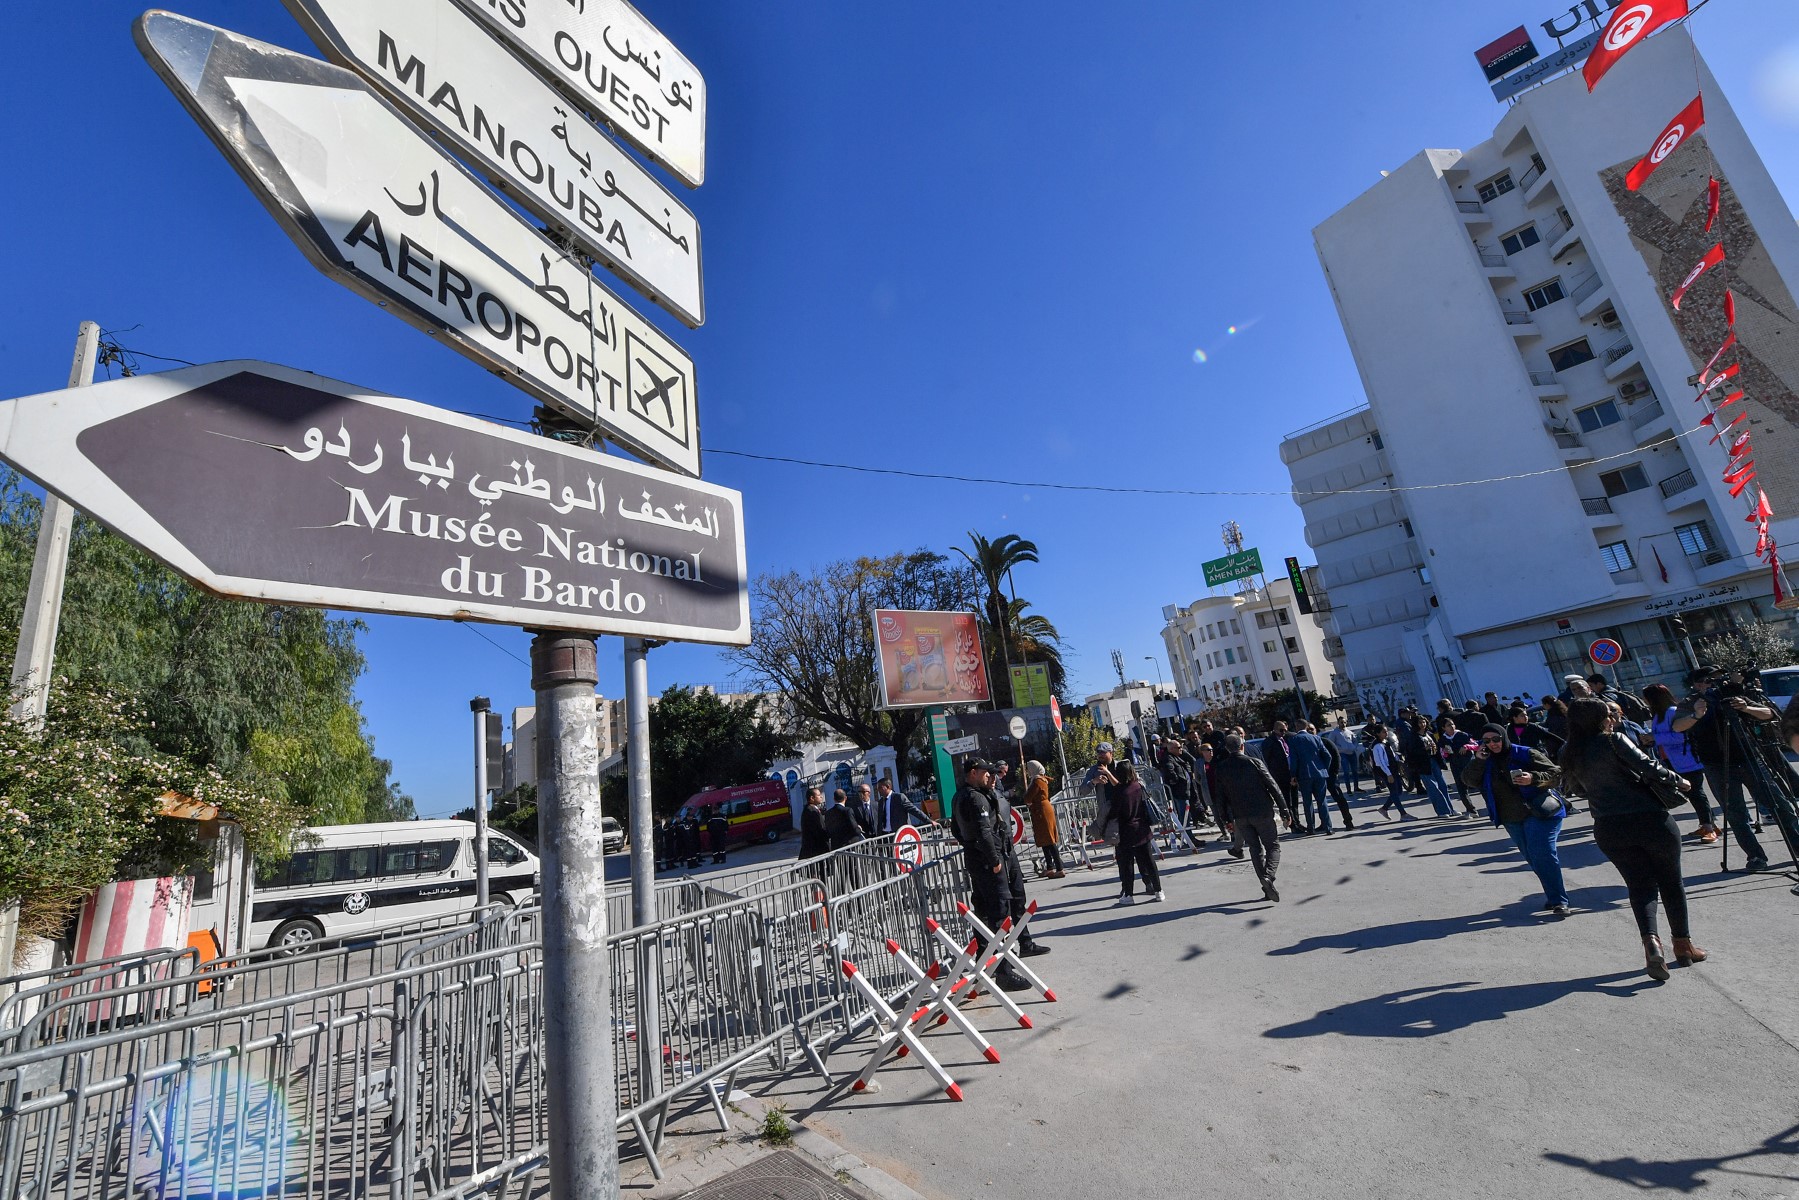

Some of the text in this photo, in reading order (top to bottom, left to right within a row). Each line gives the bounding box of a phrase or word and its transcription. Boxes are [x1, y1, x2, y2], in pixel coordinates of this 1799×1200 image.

[1540, 0, 1624, 38] UI
[554, 31, 670, 143] OUEST
[603, 25, 692, 113] تونس
[377, 29, 633, 260] MANOUBA
[551, 105, 690, 256] منوبة
[383, 169, 618, 352] المطار
[344, 210, 622, 413] AEROPORT
[468, 460, 605, 515] الوطني
[618, 488, 720, 539] المتحف
[344, 487, 704, 583] Musée National
[1209, 563, 1256, 582] AMEN BAN
[441, 556, 647, 615] du Bardo
